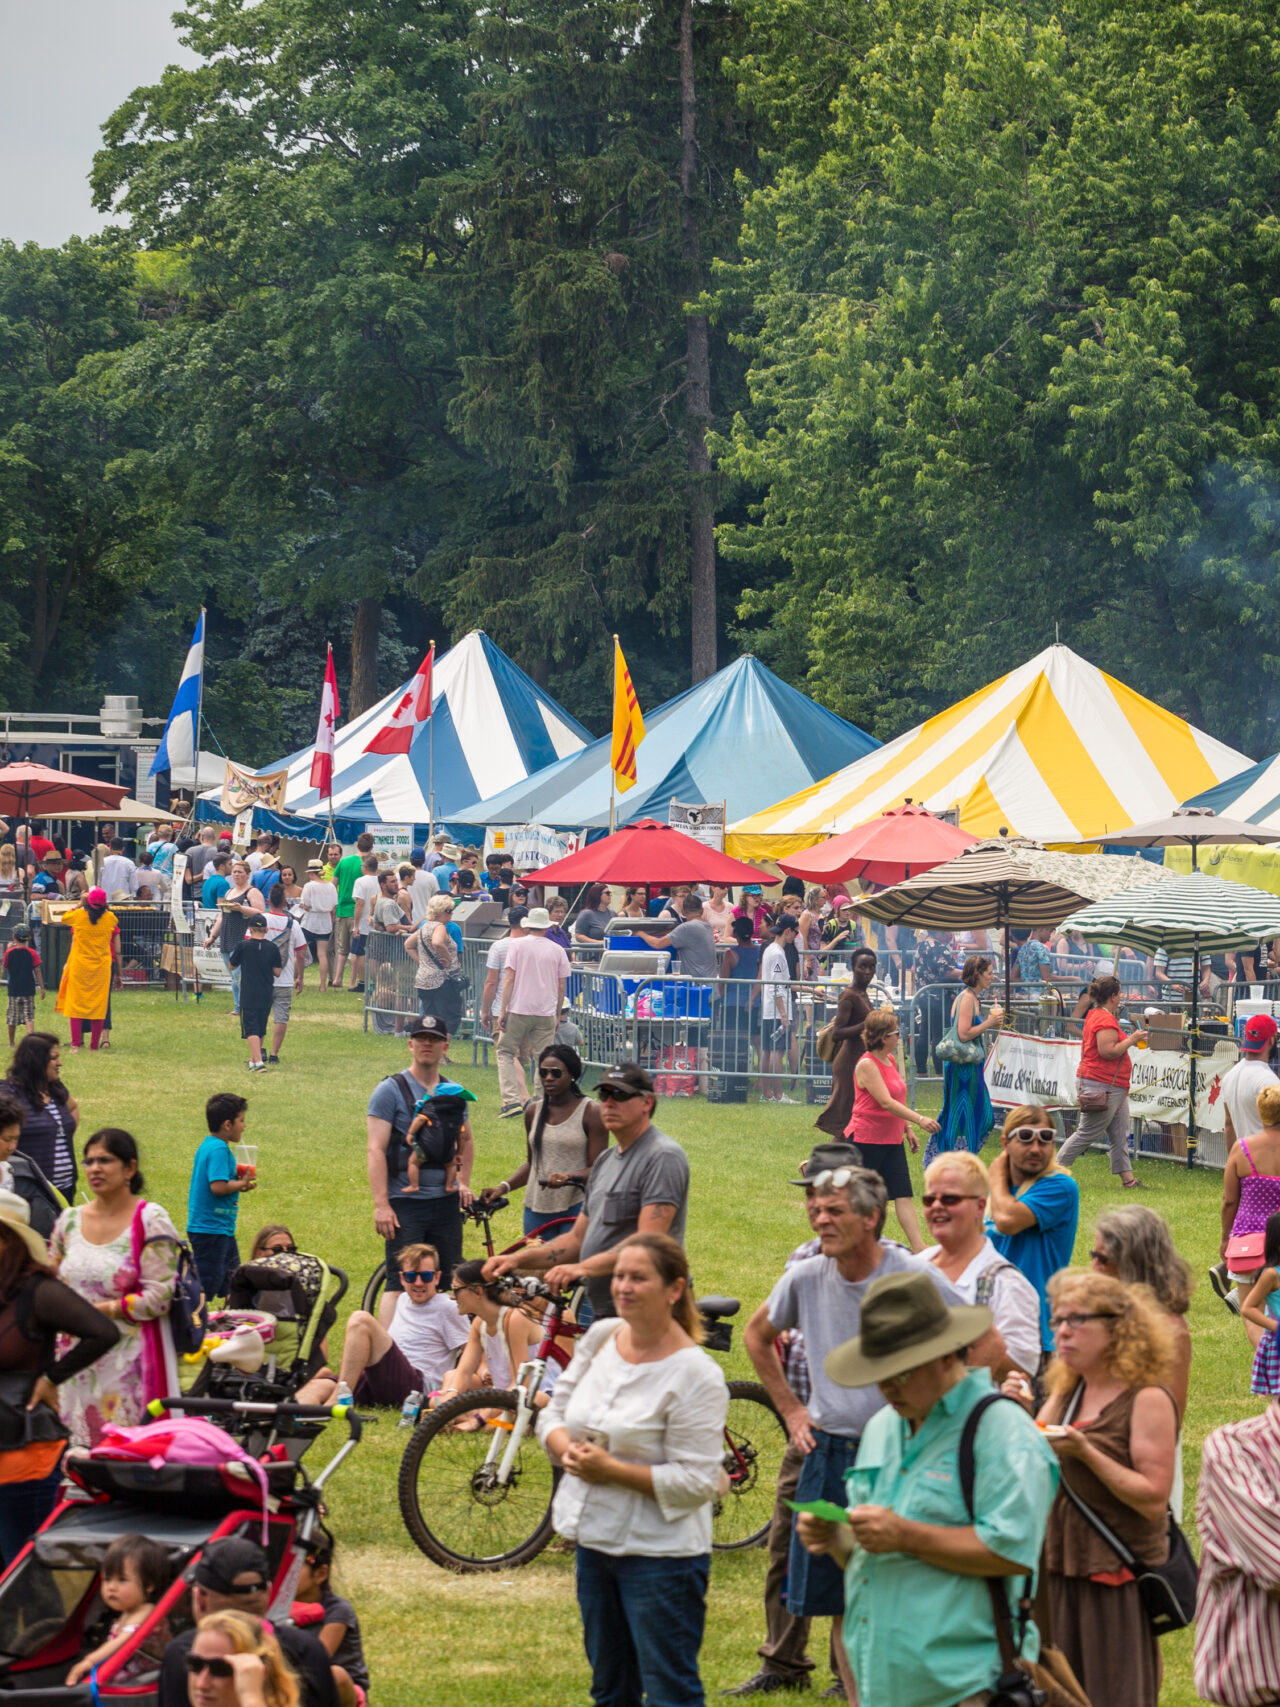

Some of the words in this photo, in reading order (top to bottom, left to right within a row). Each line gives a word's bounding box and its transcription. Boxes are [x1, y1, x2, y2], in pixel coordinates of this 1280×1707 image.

[396, 835, 410, 845] FOODS
[1132, 1064, 1158, 1087] CANADA
[1160, 1066, 1206, 1092] ASSOCIAON
